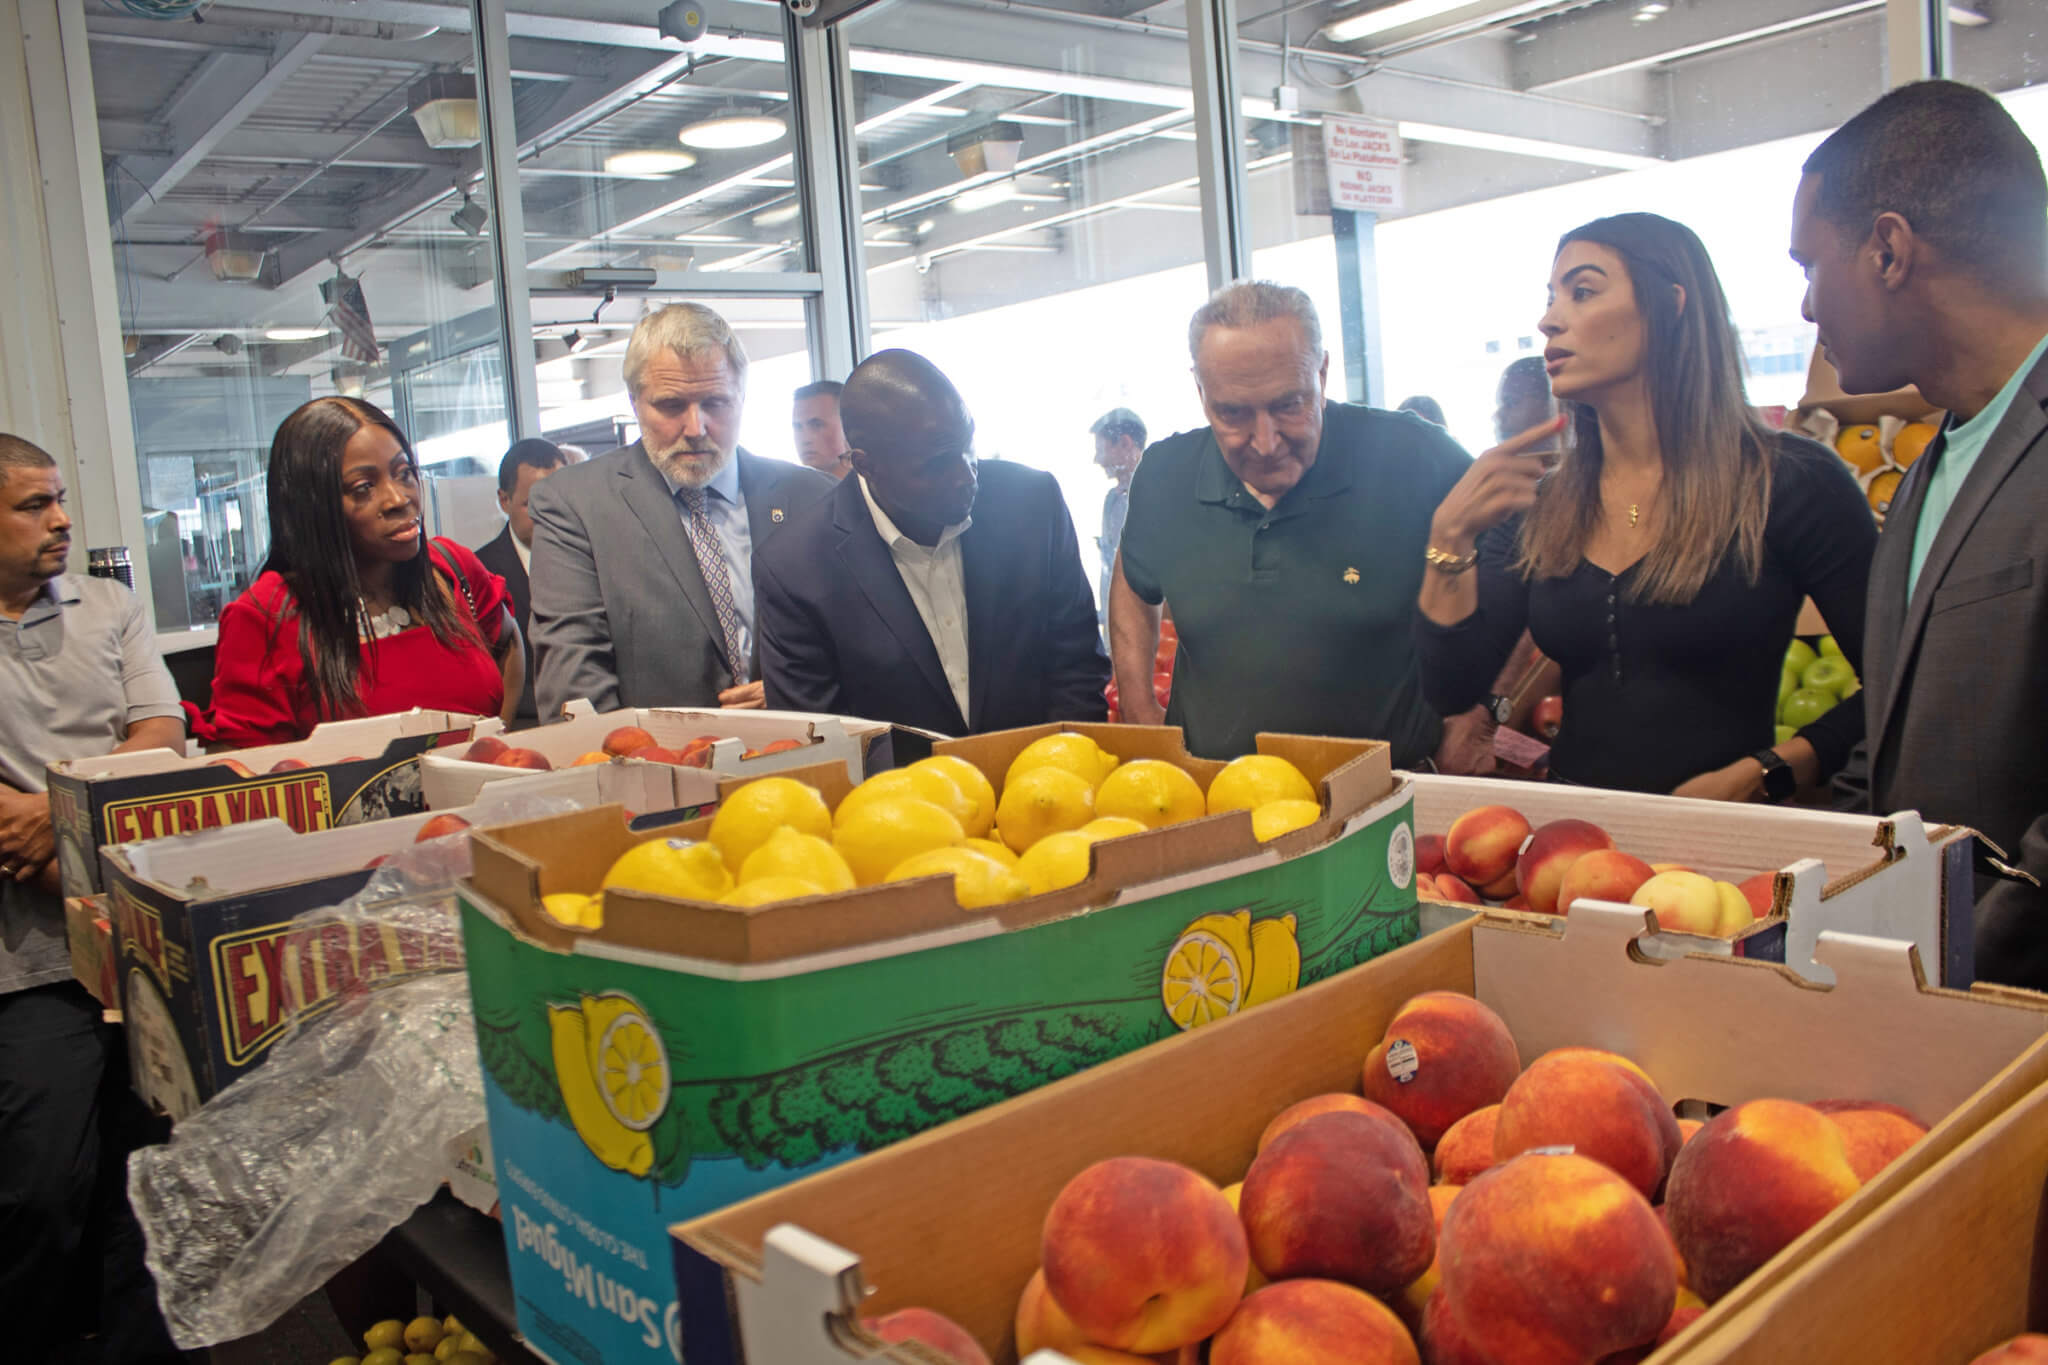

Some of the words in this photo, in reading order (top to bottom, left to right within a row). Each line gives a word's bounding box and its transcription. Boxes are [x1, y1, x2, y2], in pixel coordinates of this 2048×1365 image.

[1356, 170, 1373, 182] NO
[114, 796, 223, 845] EXTRA
[597, 1271, 662, 1349] San
